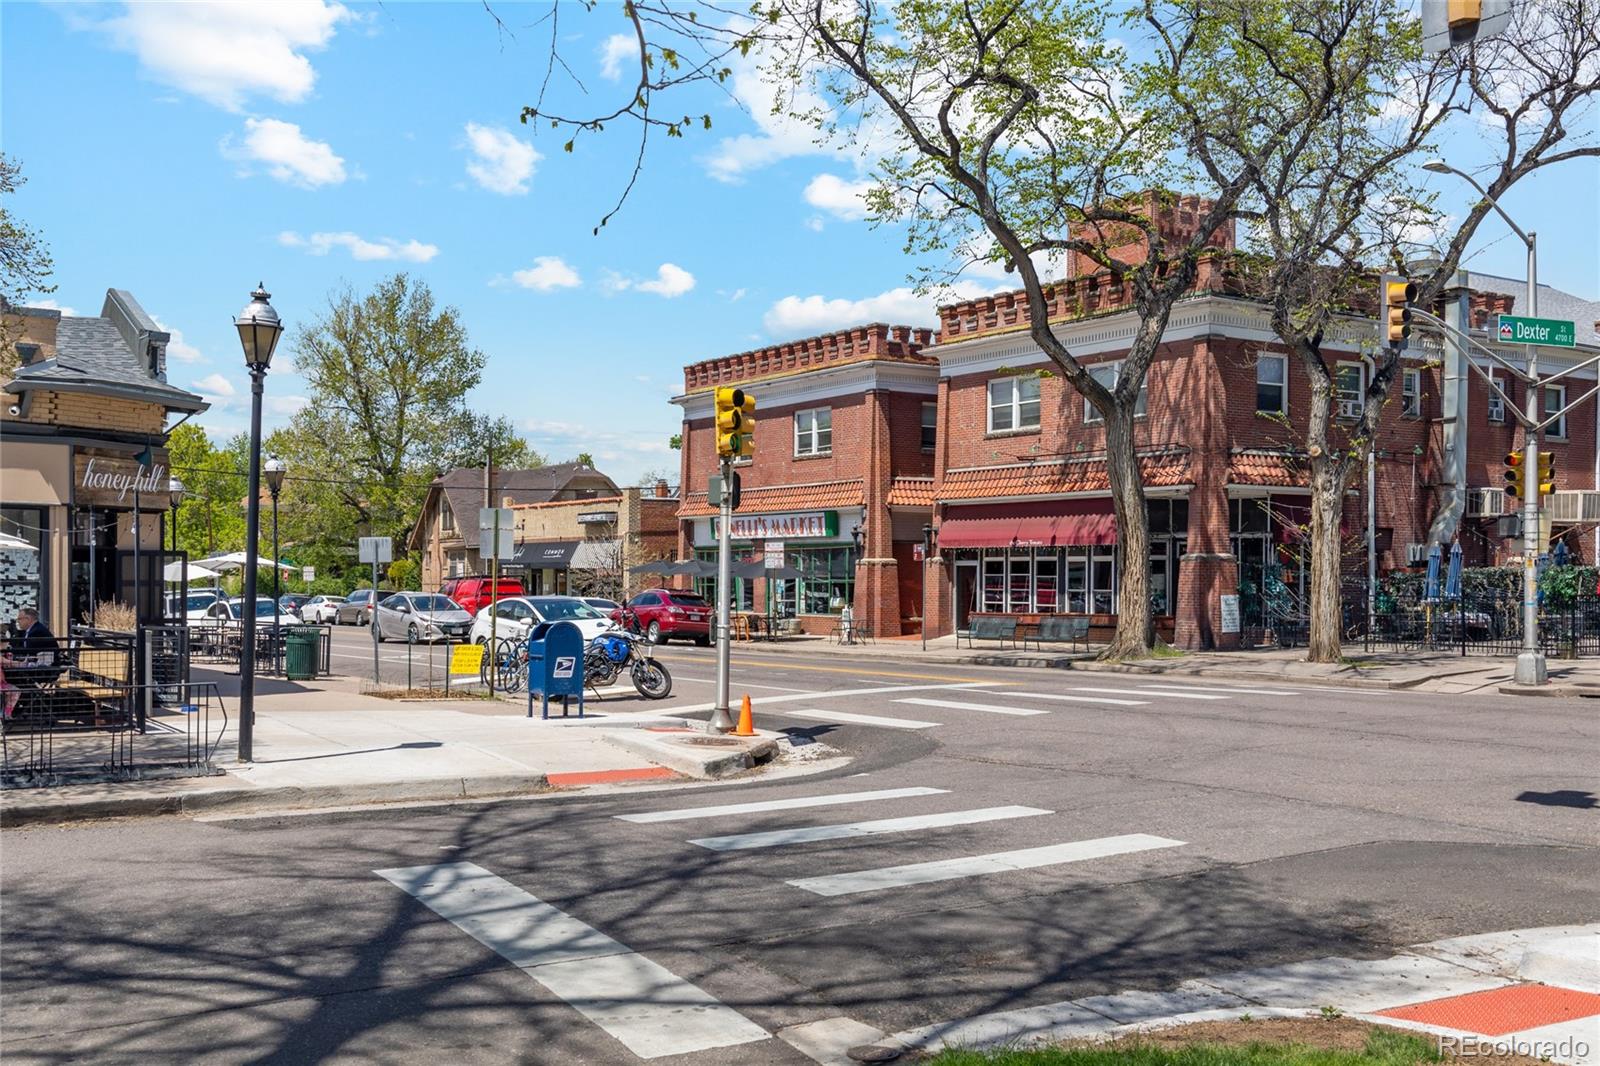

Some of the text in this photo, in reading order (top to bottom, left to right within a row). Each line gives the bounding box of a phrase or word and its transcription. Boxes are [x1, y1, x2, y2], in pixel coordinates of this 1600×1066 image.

[1516, 322, 1551, 341] Dexter
[1560, 325, 1567, 333] St
[1555, 333, 1573, 343] 4700 E
[82, 458, 164, 501] honey hill
[771, 515, 825, 536] MARKET
